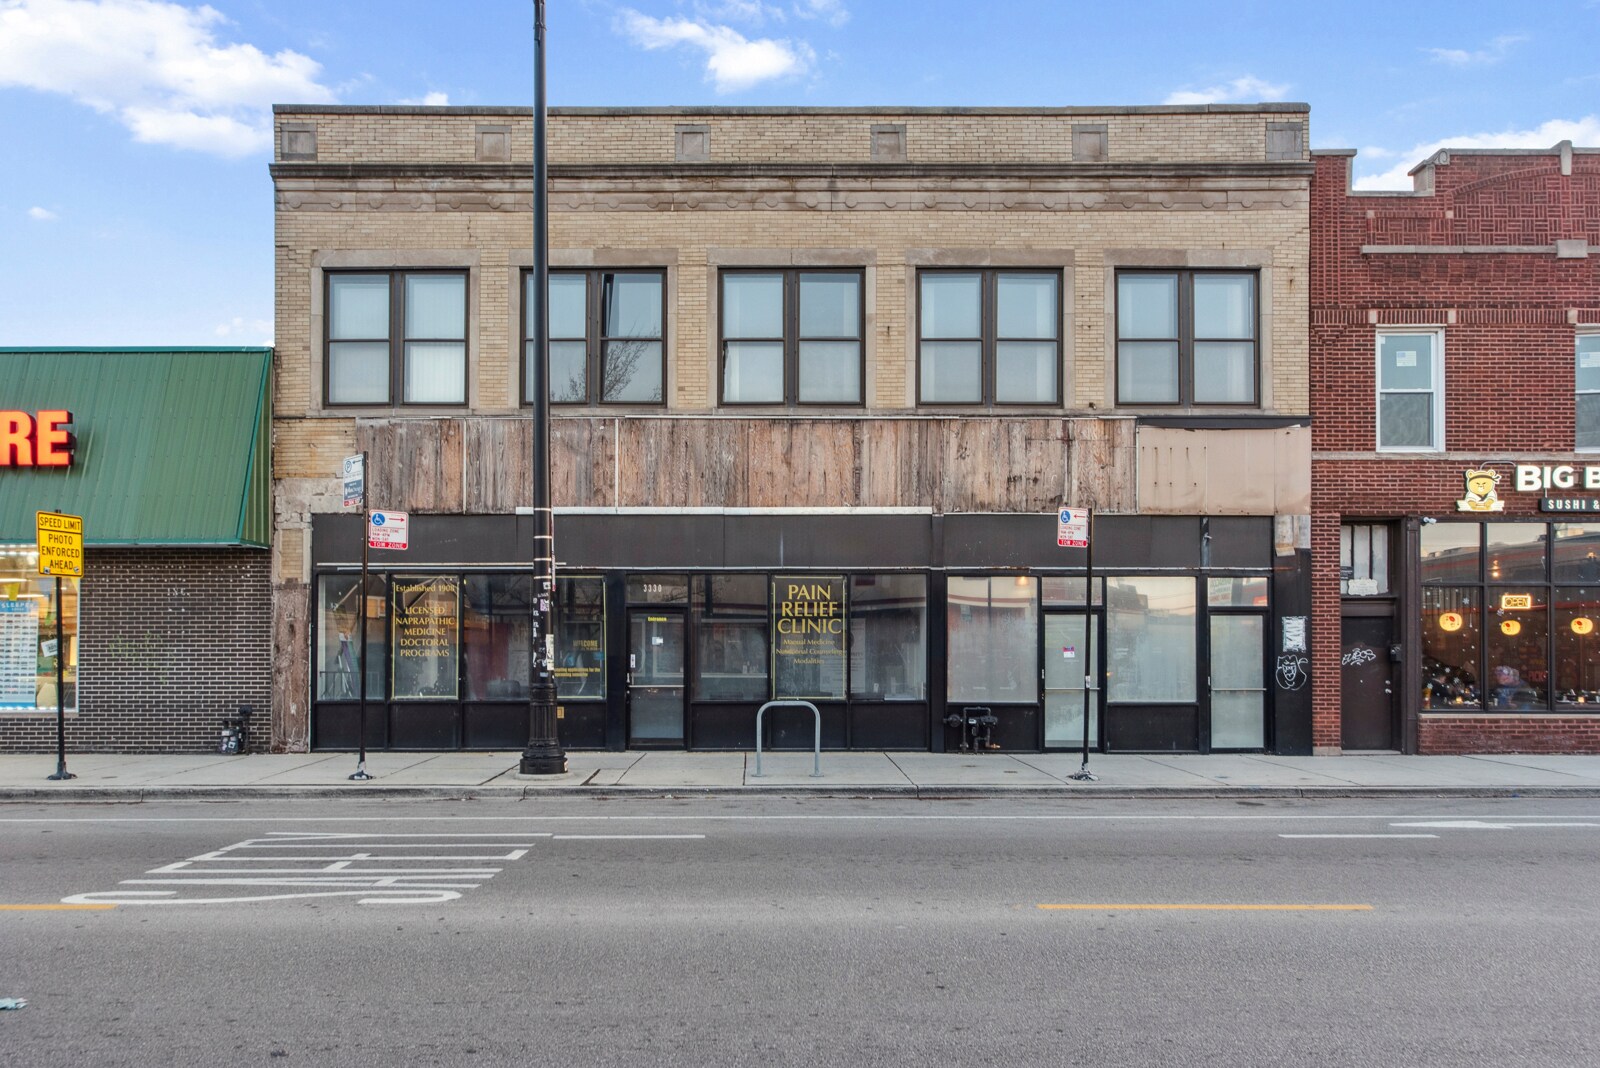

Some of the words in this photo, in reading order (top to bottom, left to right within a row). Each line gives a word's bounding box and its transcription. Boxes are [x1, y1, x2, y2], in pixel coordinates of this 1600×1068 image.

[0, 410, 73, 467] RE
[1516, 465, 1574, 491] BIG
[1548, 499, 1585, 509] SUSHI
[40, 516, 61, 528] SPEED
[64, 519, 80, 531] LIMIT
[48, 533, 73, 545] PHOTO
[41, 545, 80, 558] ENFORCED
[49, 559, 74, 570] AHEAD
[395, 584, 436, 592] Established
[438, 584, 455, 592] 1908
[643, 584, 662, 592] 3330
[788, 584, 831, 600] PAIN
[1504, 597, 1528, 608] OPEN
[405, 606, 445, 615] LICENSED
[781, 601, 838, 617] RELIEF
[395, 617, 455, 625] NAPRAPATHIC
[777, 618, 842, 634] CLINIC
[404, 627, 446, 635] MEDICINE
[400, 638, 449, 647] DOCTORAL
[400, 648, 450, 657] PROGRAMS
